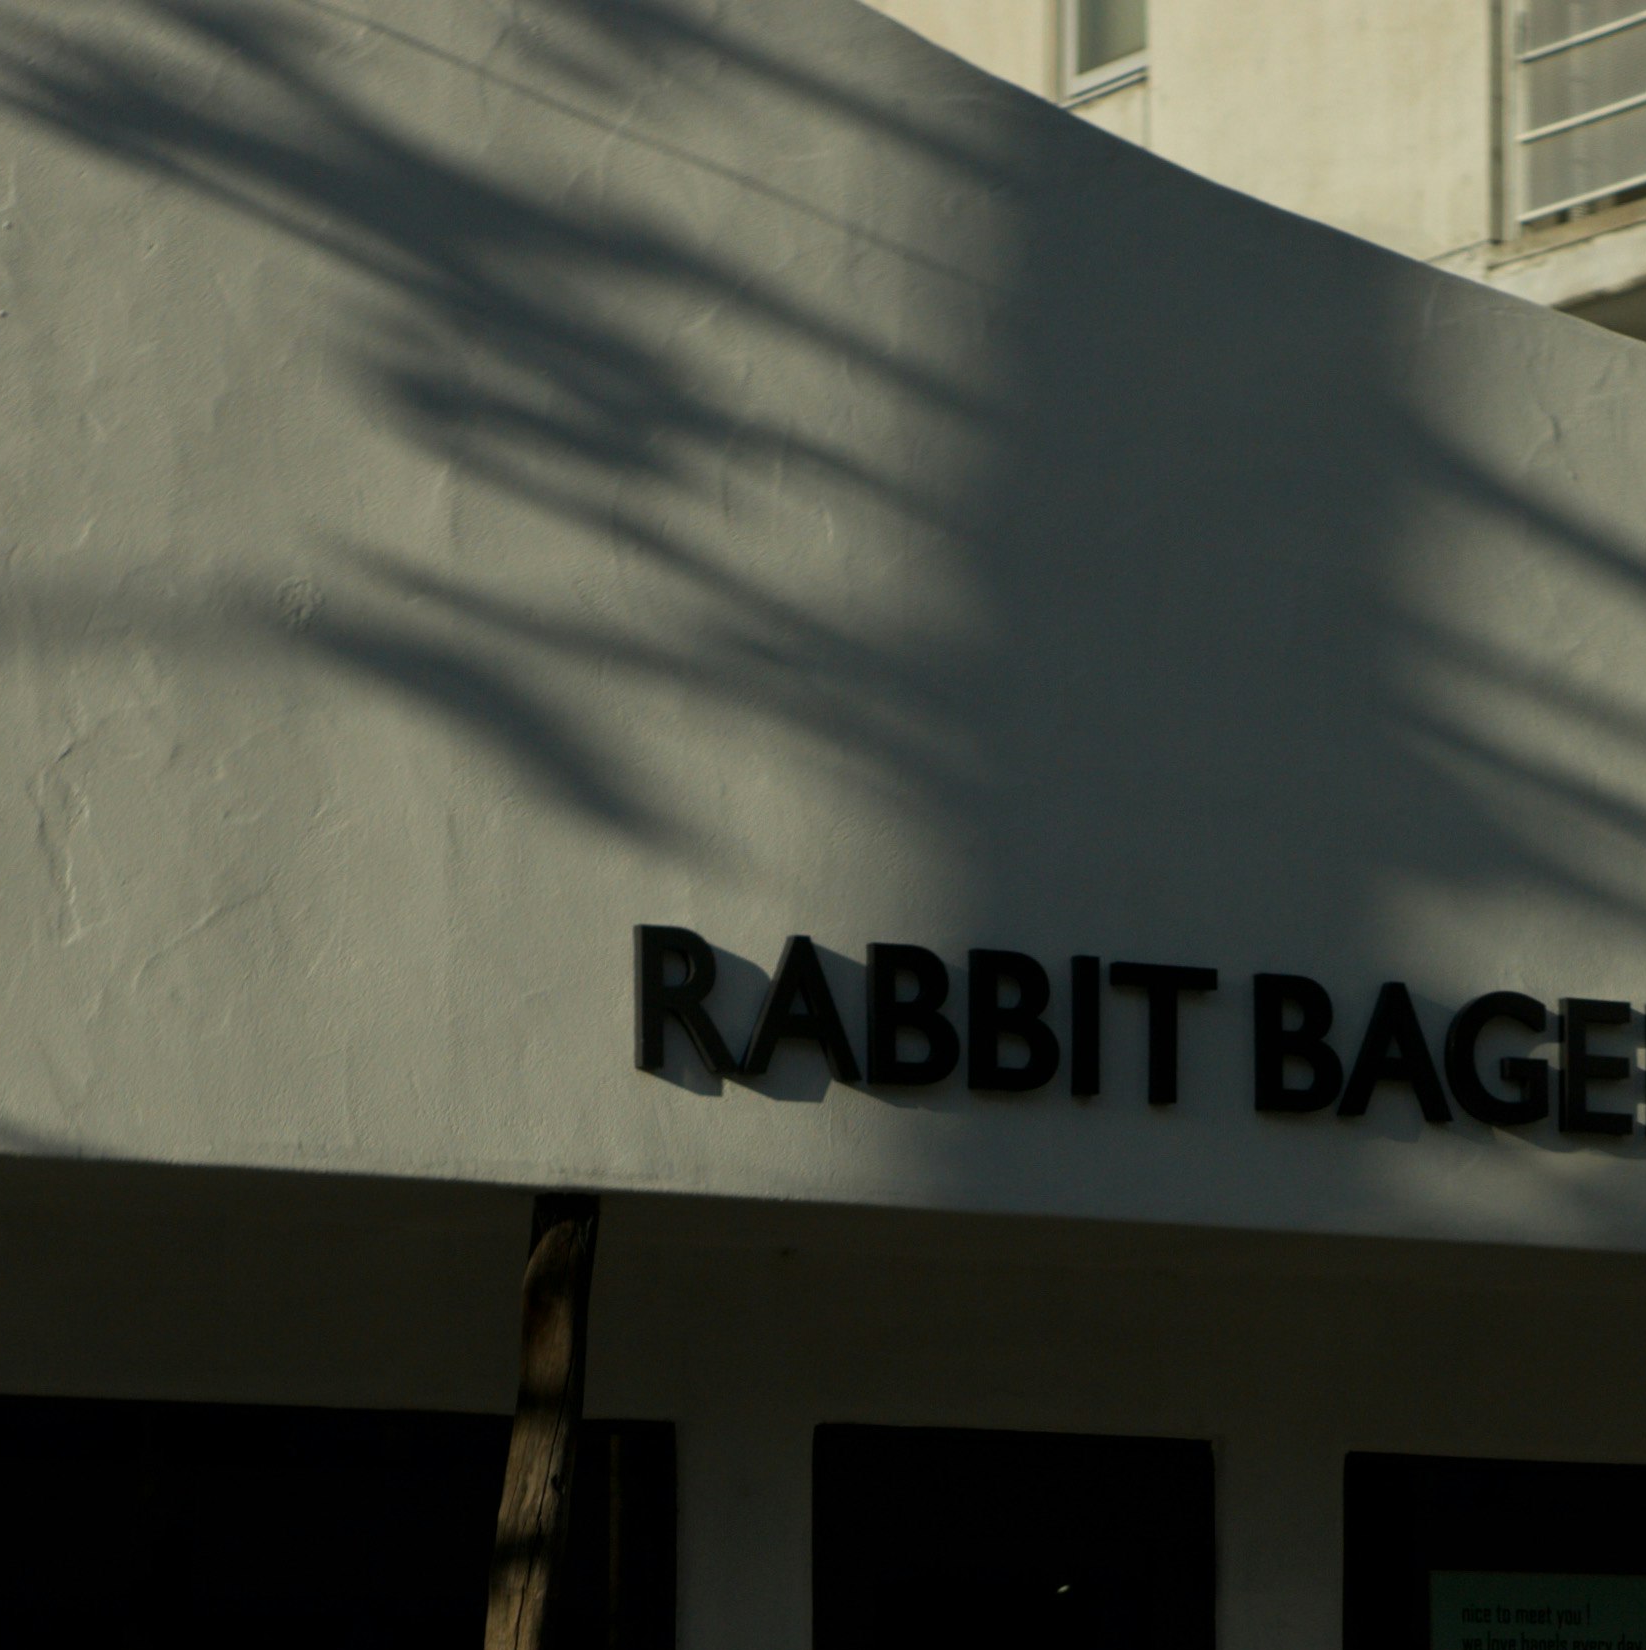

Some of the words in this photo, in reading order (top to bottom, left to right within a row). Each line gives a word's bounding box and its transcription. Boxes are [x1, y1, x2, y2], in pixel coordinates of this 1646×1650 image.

[635, 924, 1217, 1104] RABBIT
[1461, 1603, 1492, 1625] nice
[1496, 1603, 1511, 1625] to
[1515, 1604, 1552, 1625] meet
